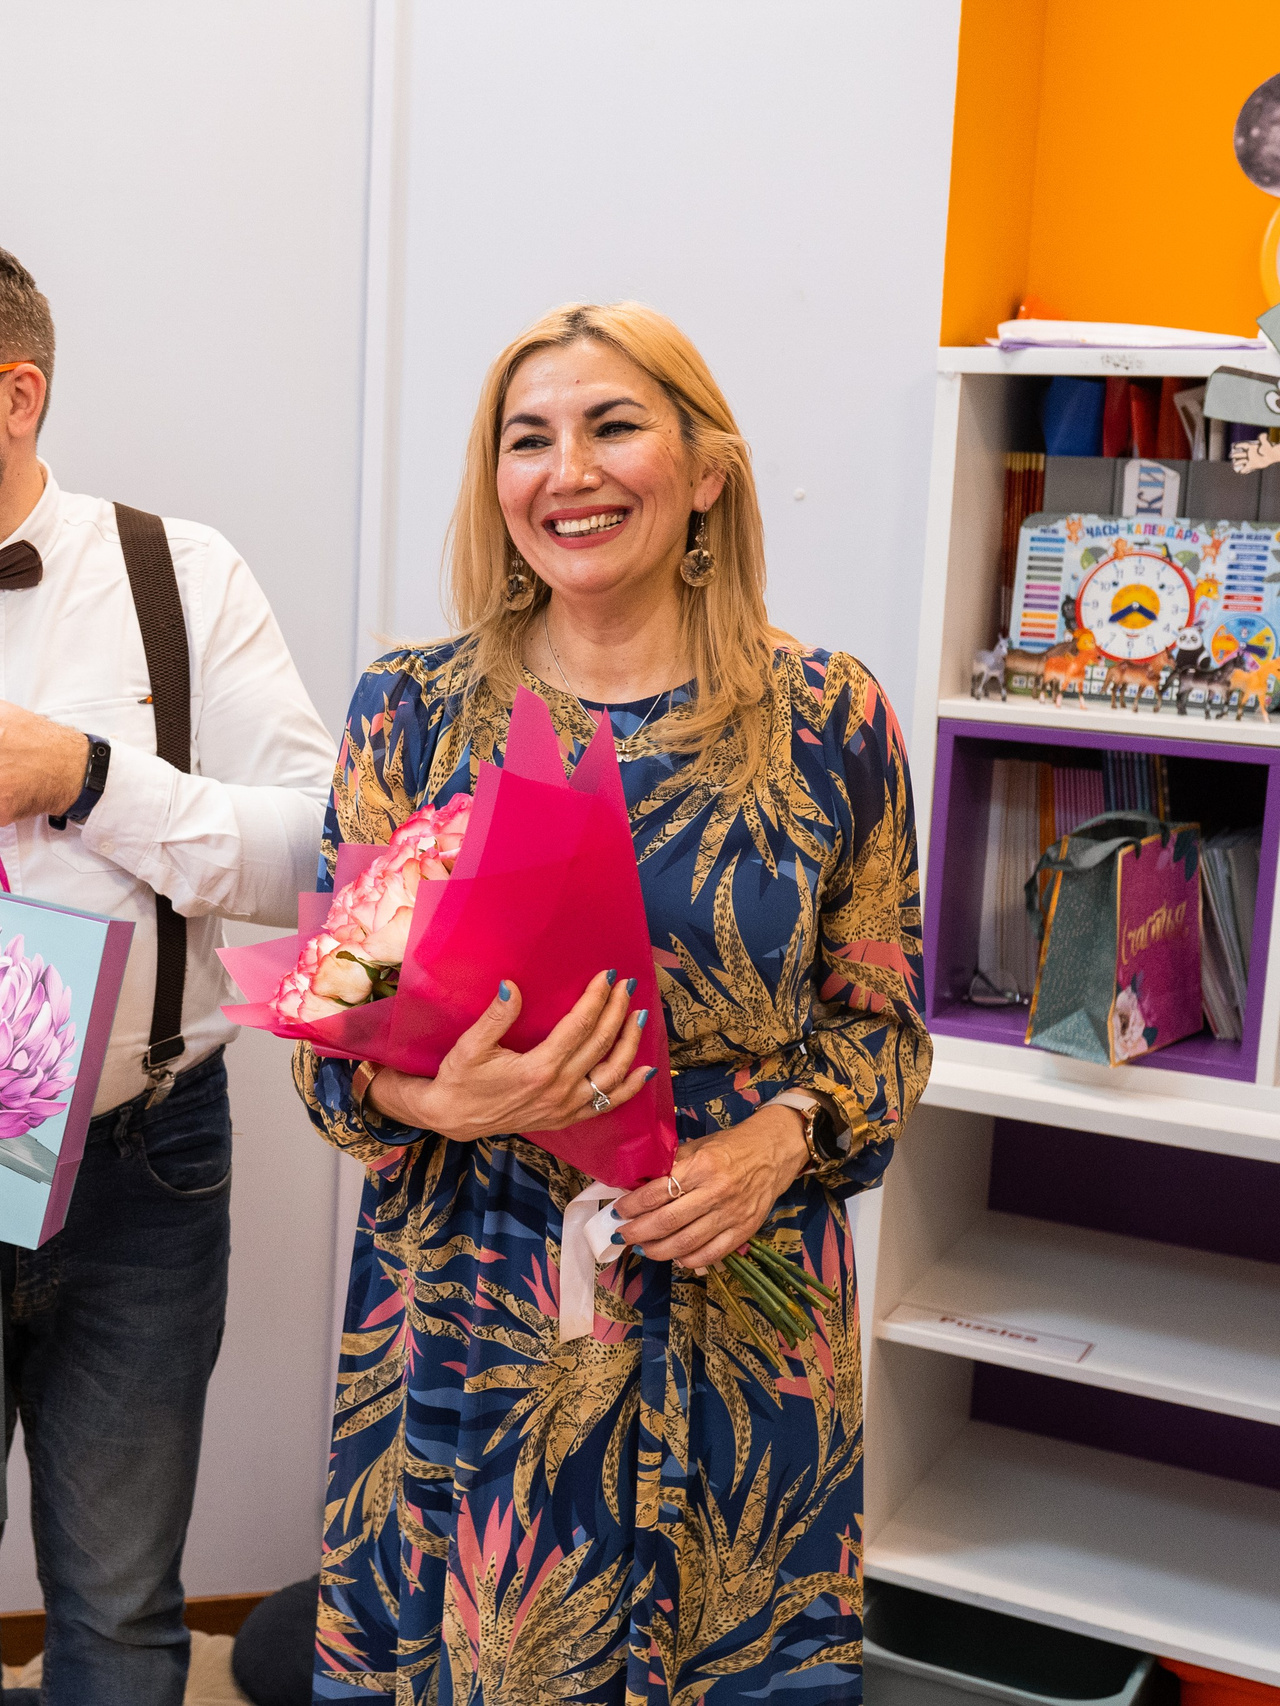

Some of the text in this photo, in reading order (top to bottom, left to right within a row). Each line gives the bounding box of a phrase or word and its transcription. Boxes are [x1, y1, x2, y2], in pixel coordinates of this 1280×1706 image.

[1086, 522, 1199, 543] ЧАСЫ-КАЛЕНДАРЬ
[1135, 564, 1146, 576] 12
[939, 1316, 1038, 1343] Puzzles
